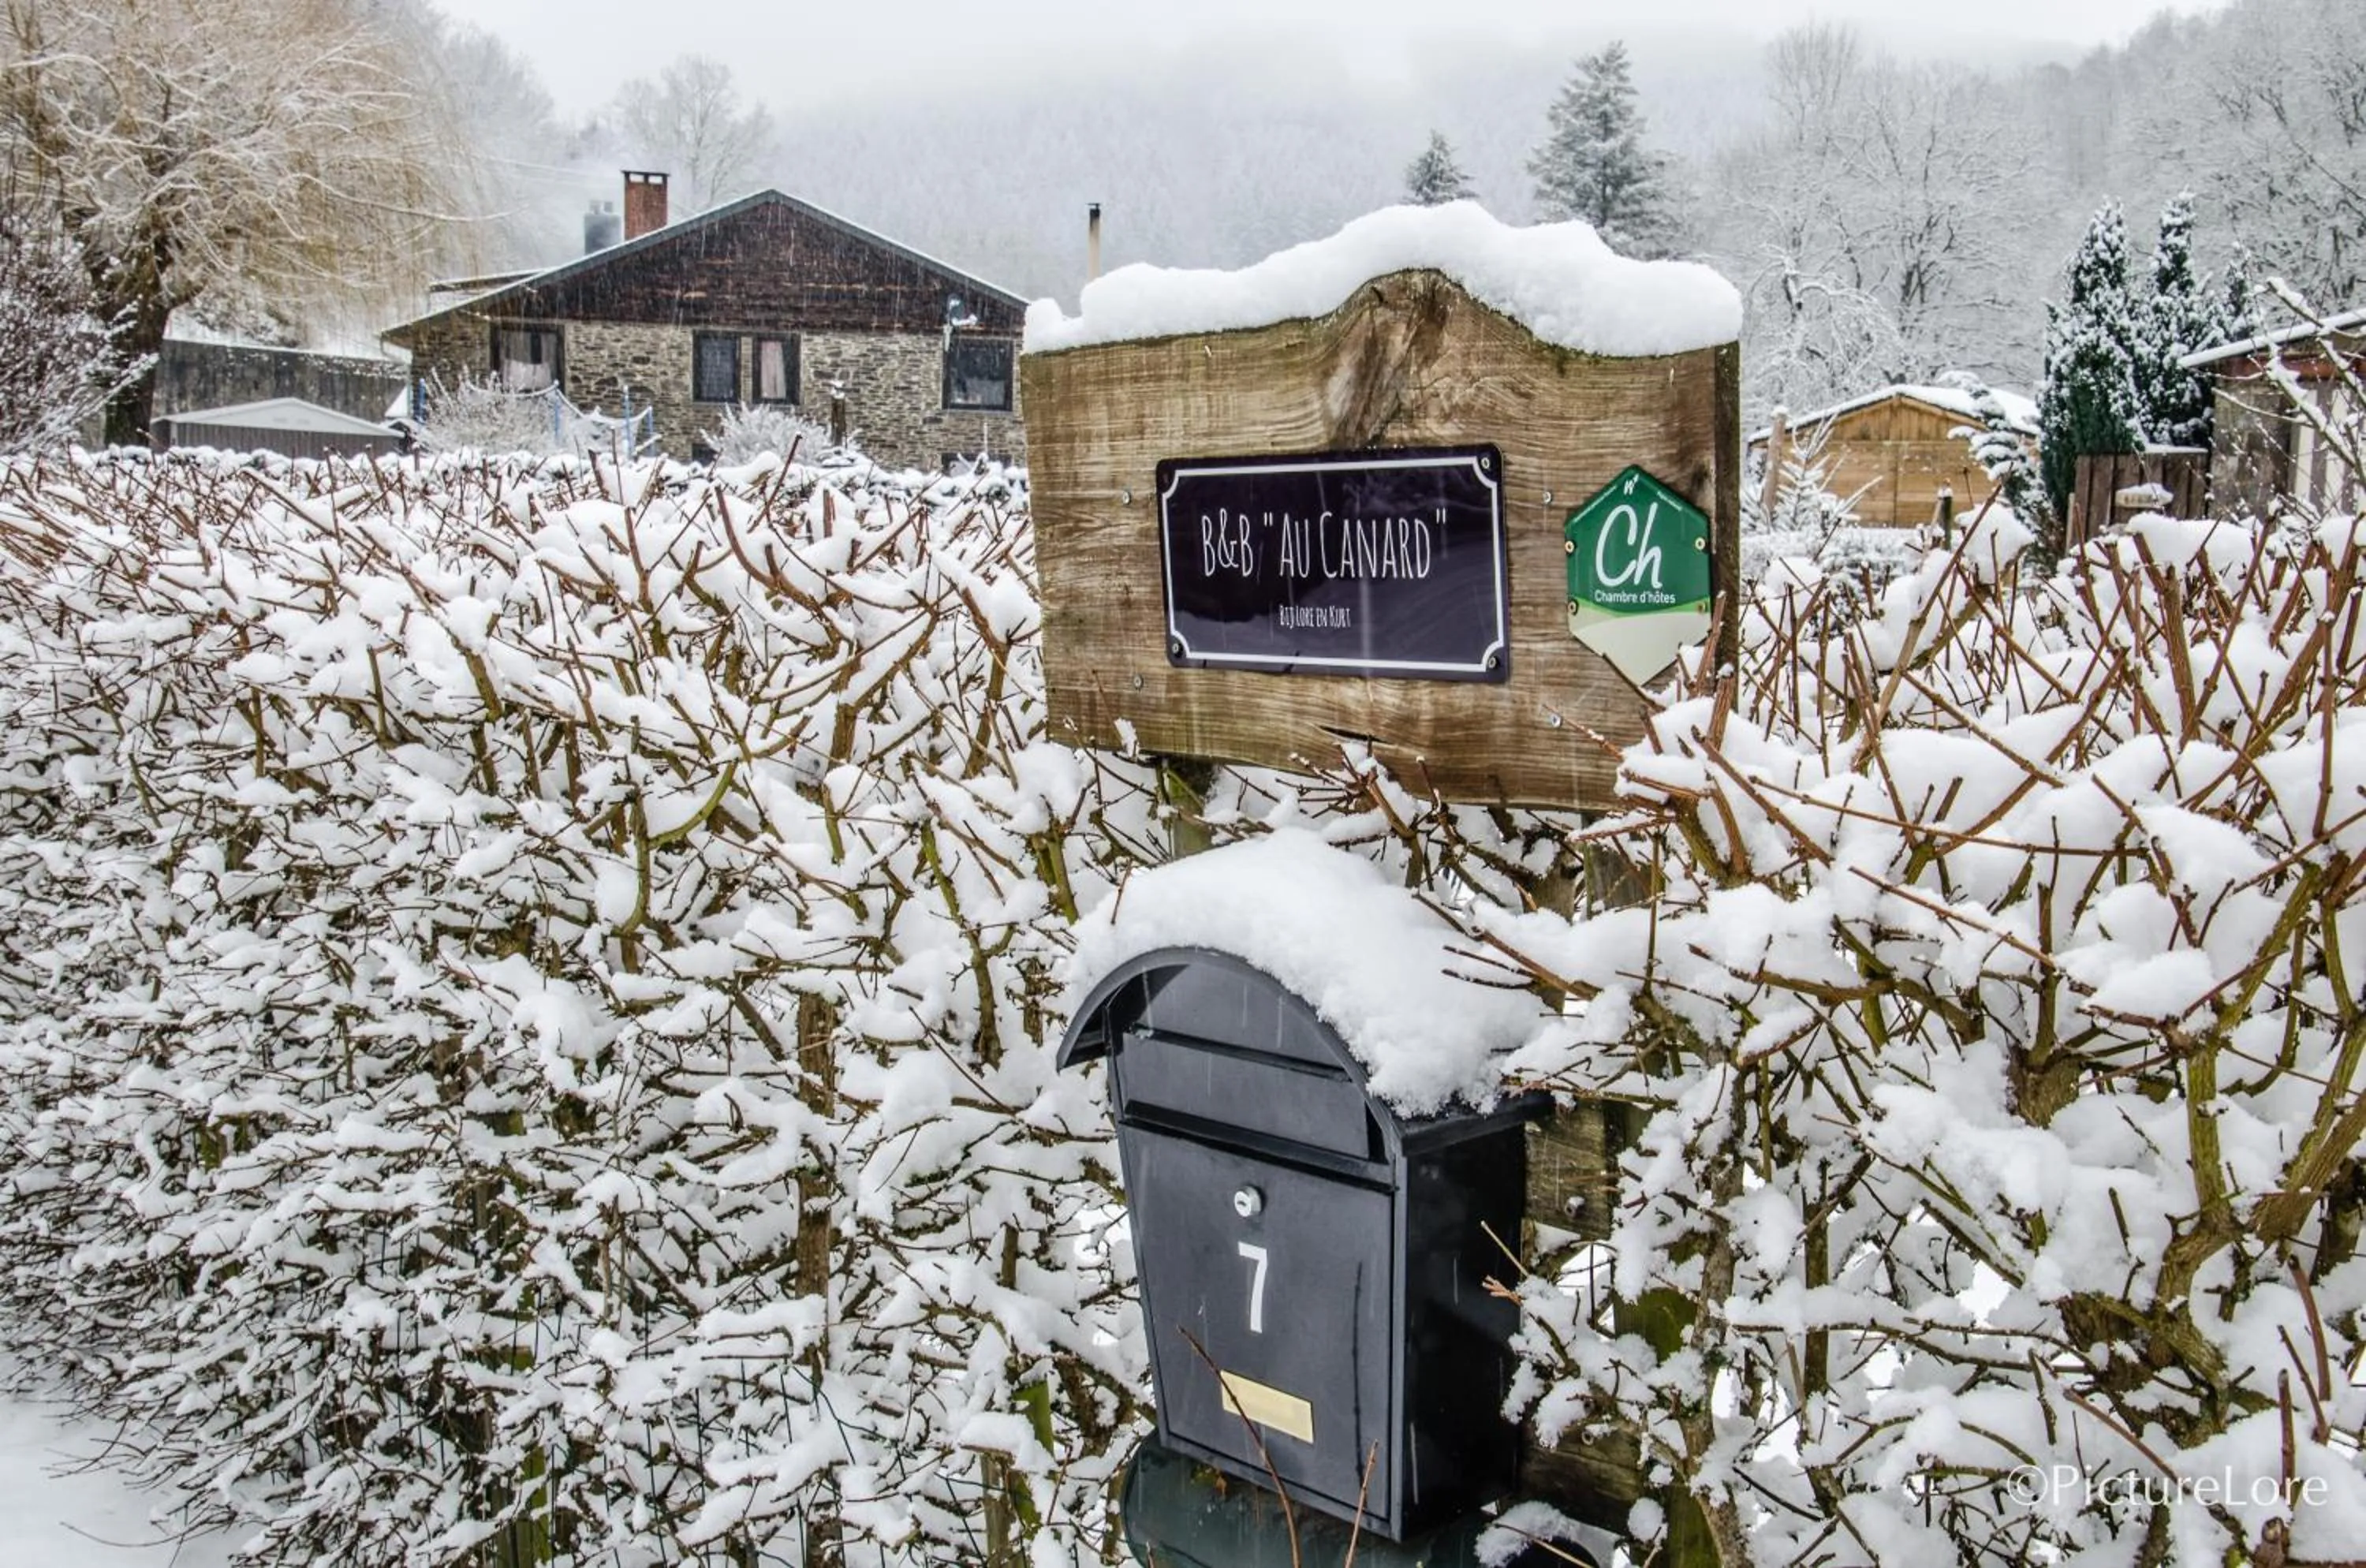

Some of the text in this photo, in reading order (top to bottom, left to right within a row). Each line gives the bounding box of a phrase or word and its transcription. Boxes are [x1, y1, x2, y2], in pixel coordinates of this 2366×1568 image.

[1201, 507, 1253, 577] B&B
[1595, 502, 1663, 588] Ch
[1595, 589, 1676, 603] Chambre d'hôtes
[1238, 1241, 1267, 1334] 7
